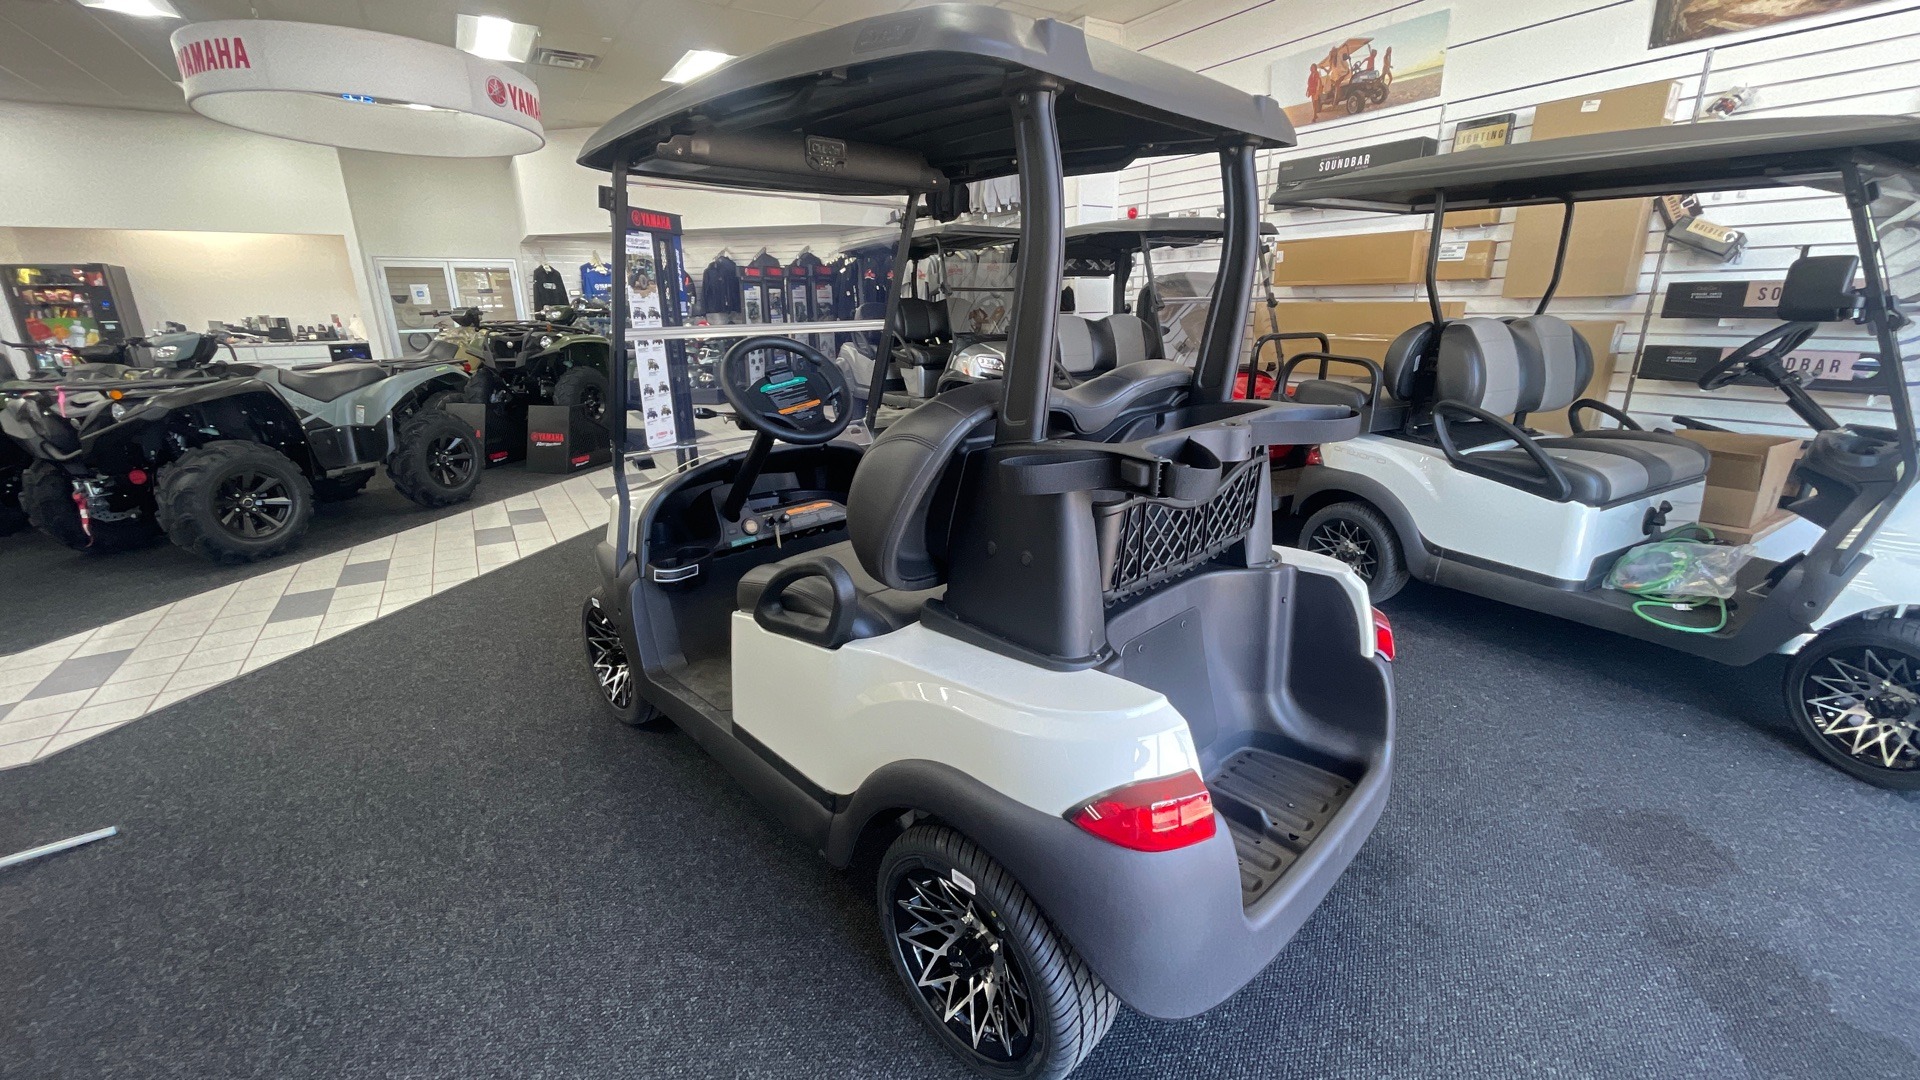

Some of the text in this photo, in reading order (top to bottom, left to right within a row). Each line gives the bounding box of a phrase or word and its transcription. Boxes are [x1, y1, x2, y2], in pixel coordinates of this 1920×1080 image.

[178, 37, 251, 79] YAMAHA
[507, 83, 541, 121] YAMA
[1456, 128, 1505, 146] LIGHTING
[1318, 153, 1371, 173] SOUNDBAR
[641, 211, 672, 231] YAMAHA
[1785, 357, 1842, 374] DBAR
[539, 432, 565, 443] YAMAHA
